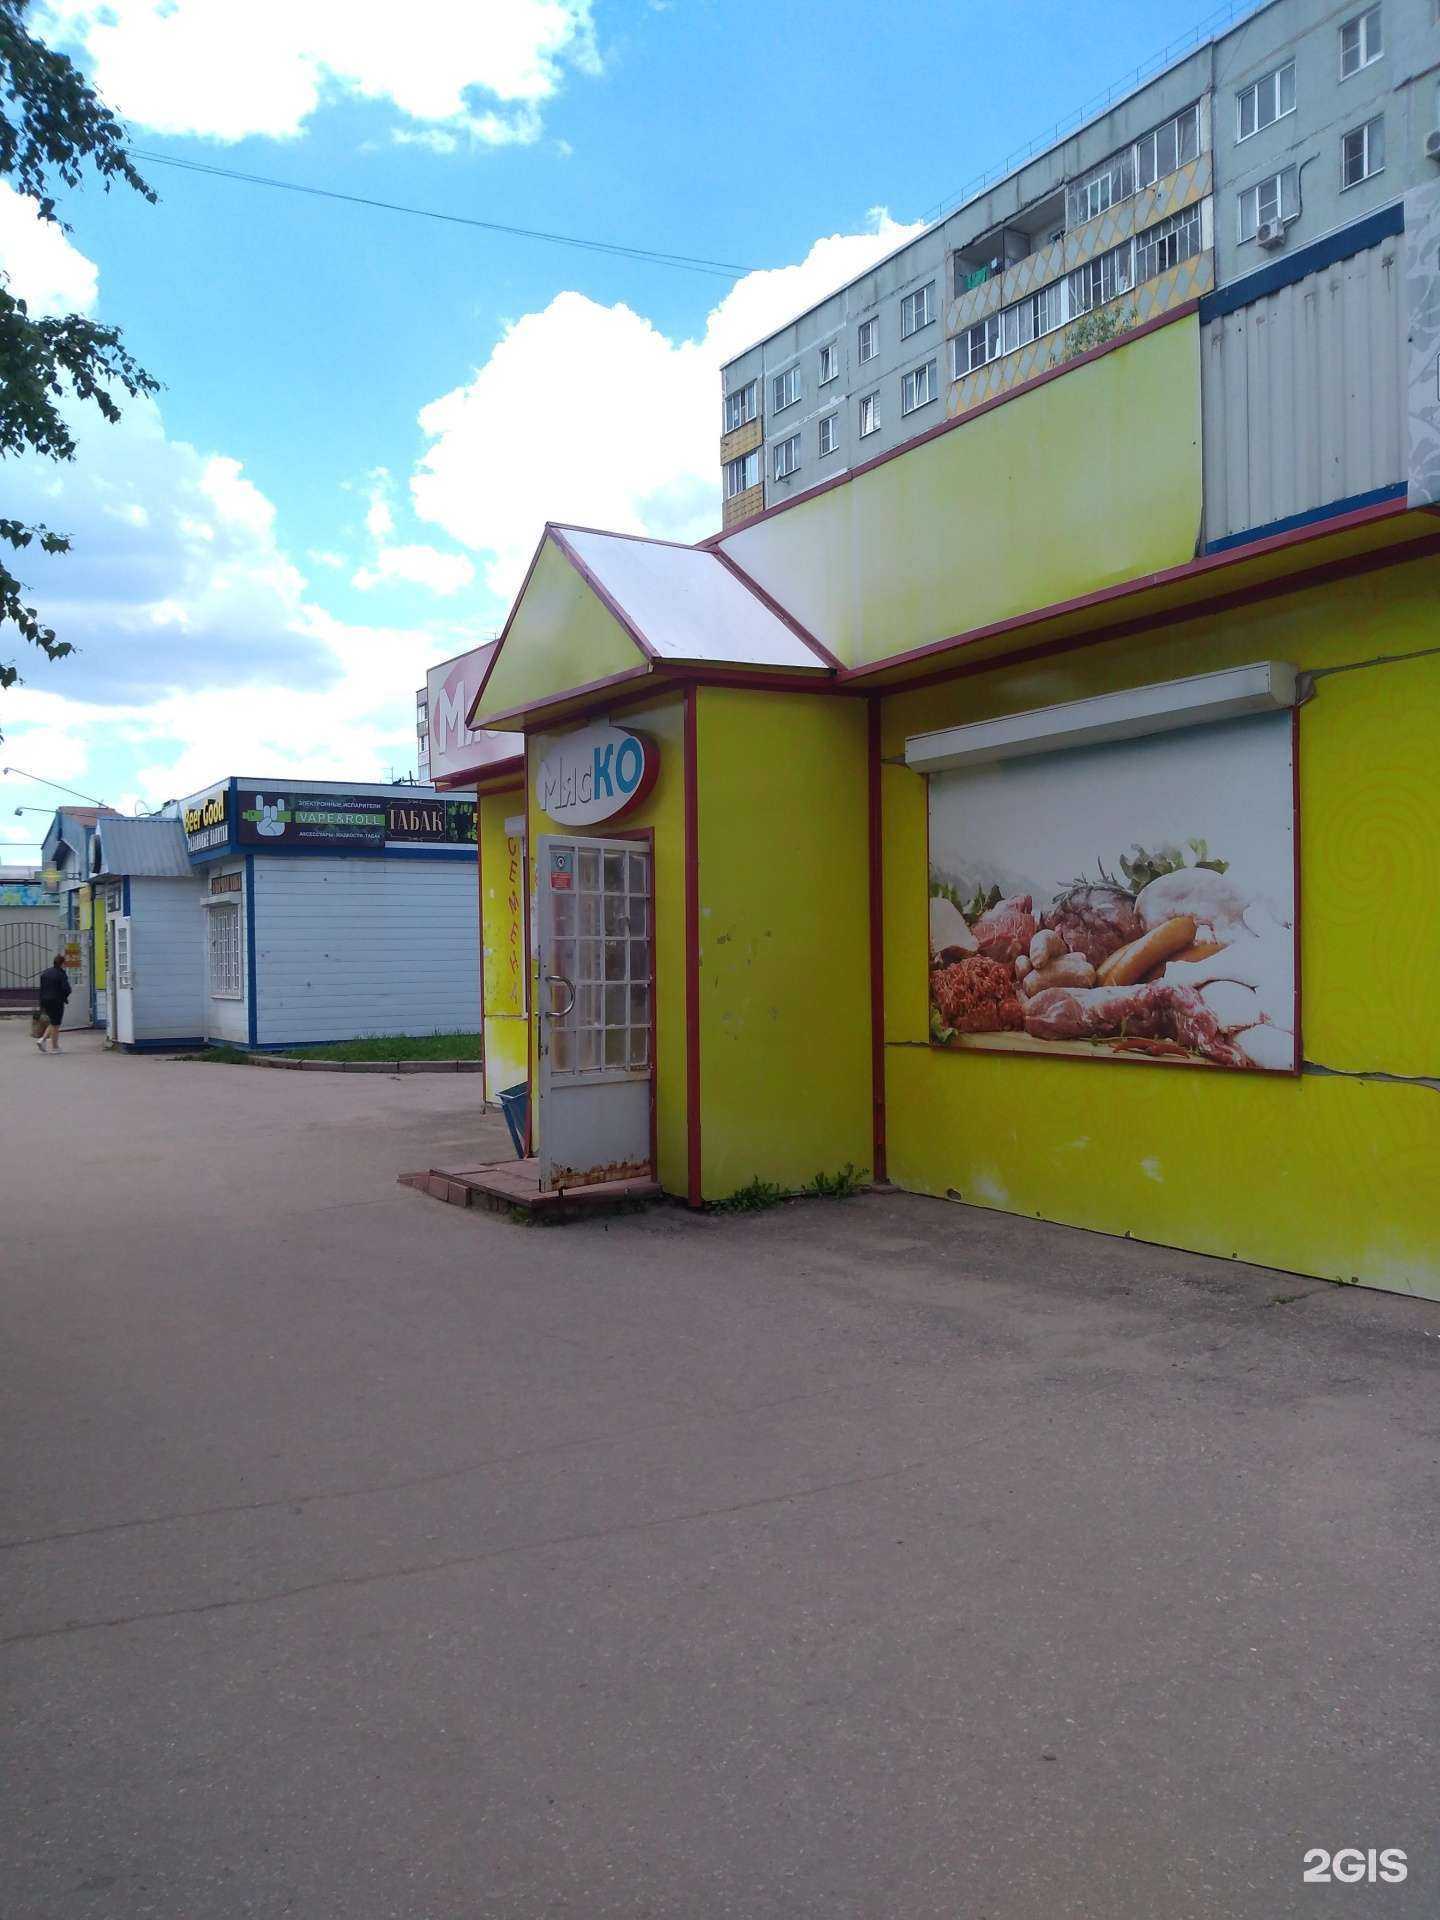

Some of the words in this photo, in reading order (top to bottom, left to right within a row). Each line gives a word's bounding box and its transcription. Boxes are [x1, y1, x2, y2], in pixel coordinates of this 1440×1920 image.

[184, 808, 201, 833] Beer
[203, 792, 224, 826] Good
[300, 812, 381, 825] VAPE&ROLL
[389, 809, 443, 831] ТАБАК
